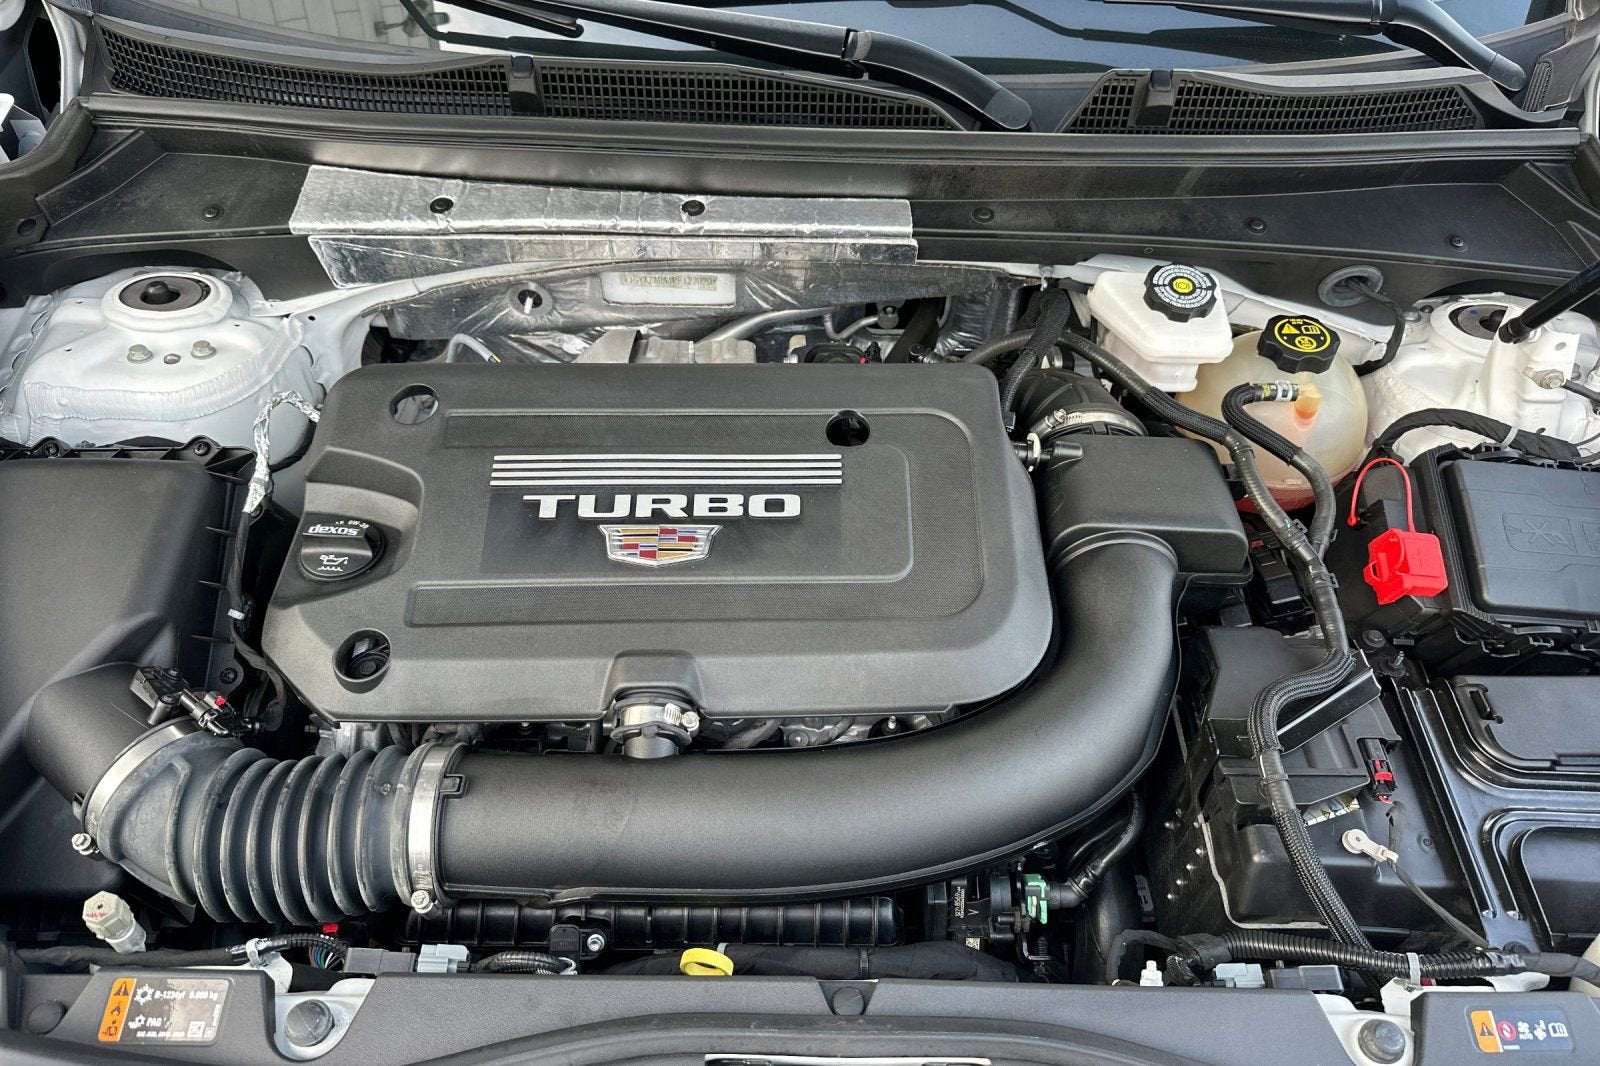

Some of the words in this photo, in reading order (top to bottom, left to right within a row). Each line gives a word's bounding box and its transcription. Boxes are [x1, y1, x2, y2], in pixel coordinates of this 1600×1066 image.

[522, 493, 801, 519] TURBO
[308, 523, 360, 536] dexos
[146, 1017, 163, 1027] PAG
